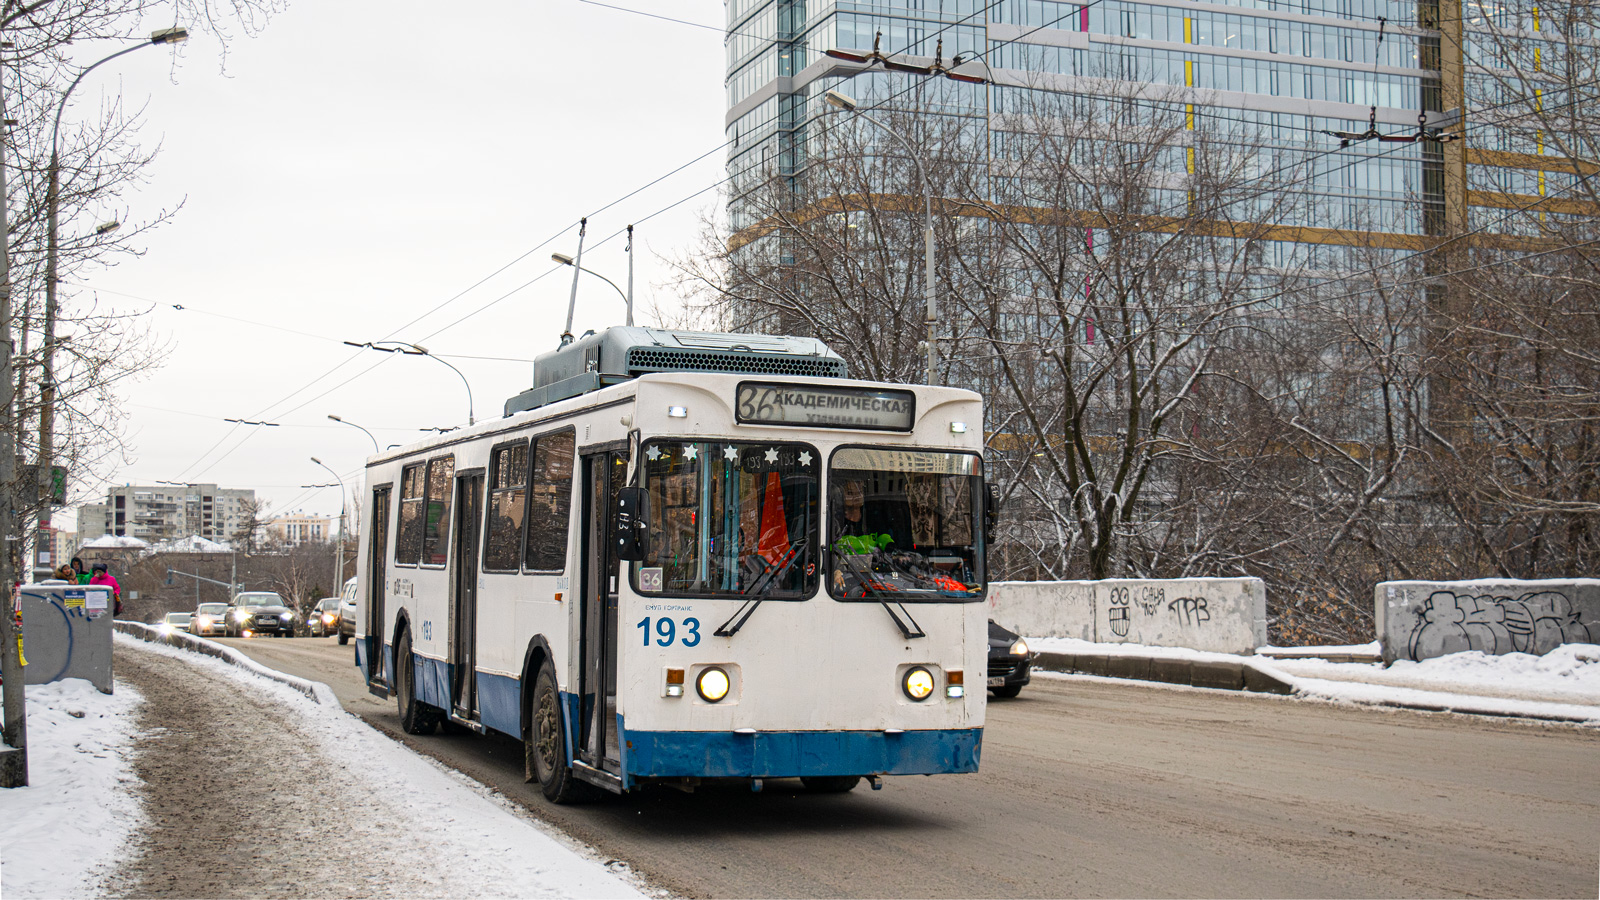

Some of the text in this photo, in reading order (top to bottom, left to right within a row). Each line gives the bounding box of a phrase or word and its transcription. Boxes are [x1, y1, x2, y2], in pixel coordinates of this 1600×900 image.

[739, 386, 778, 420] 36
[772, 392, 912, 414] АКАДЕМИЧЕСКАЯ
[643, 572, 661, 587] 36
[423, 620, 432, 641] 193
[636, 616, 702, 648] 193
